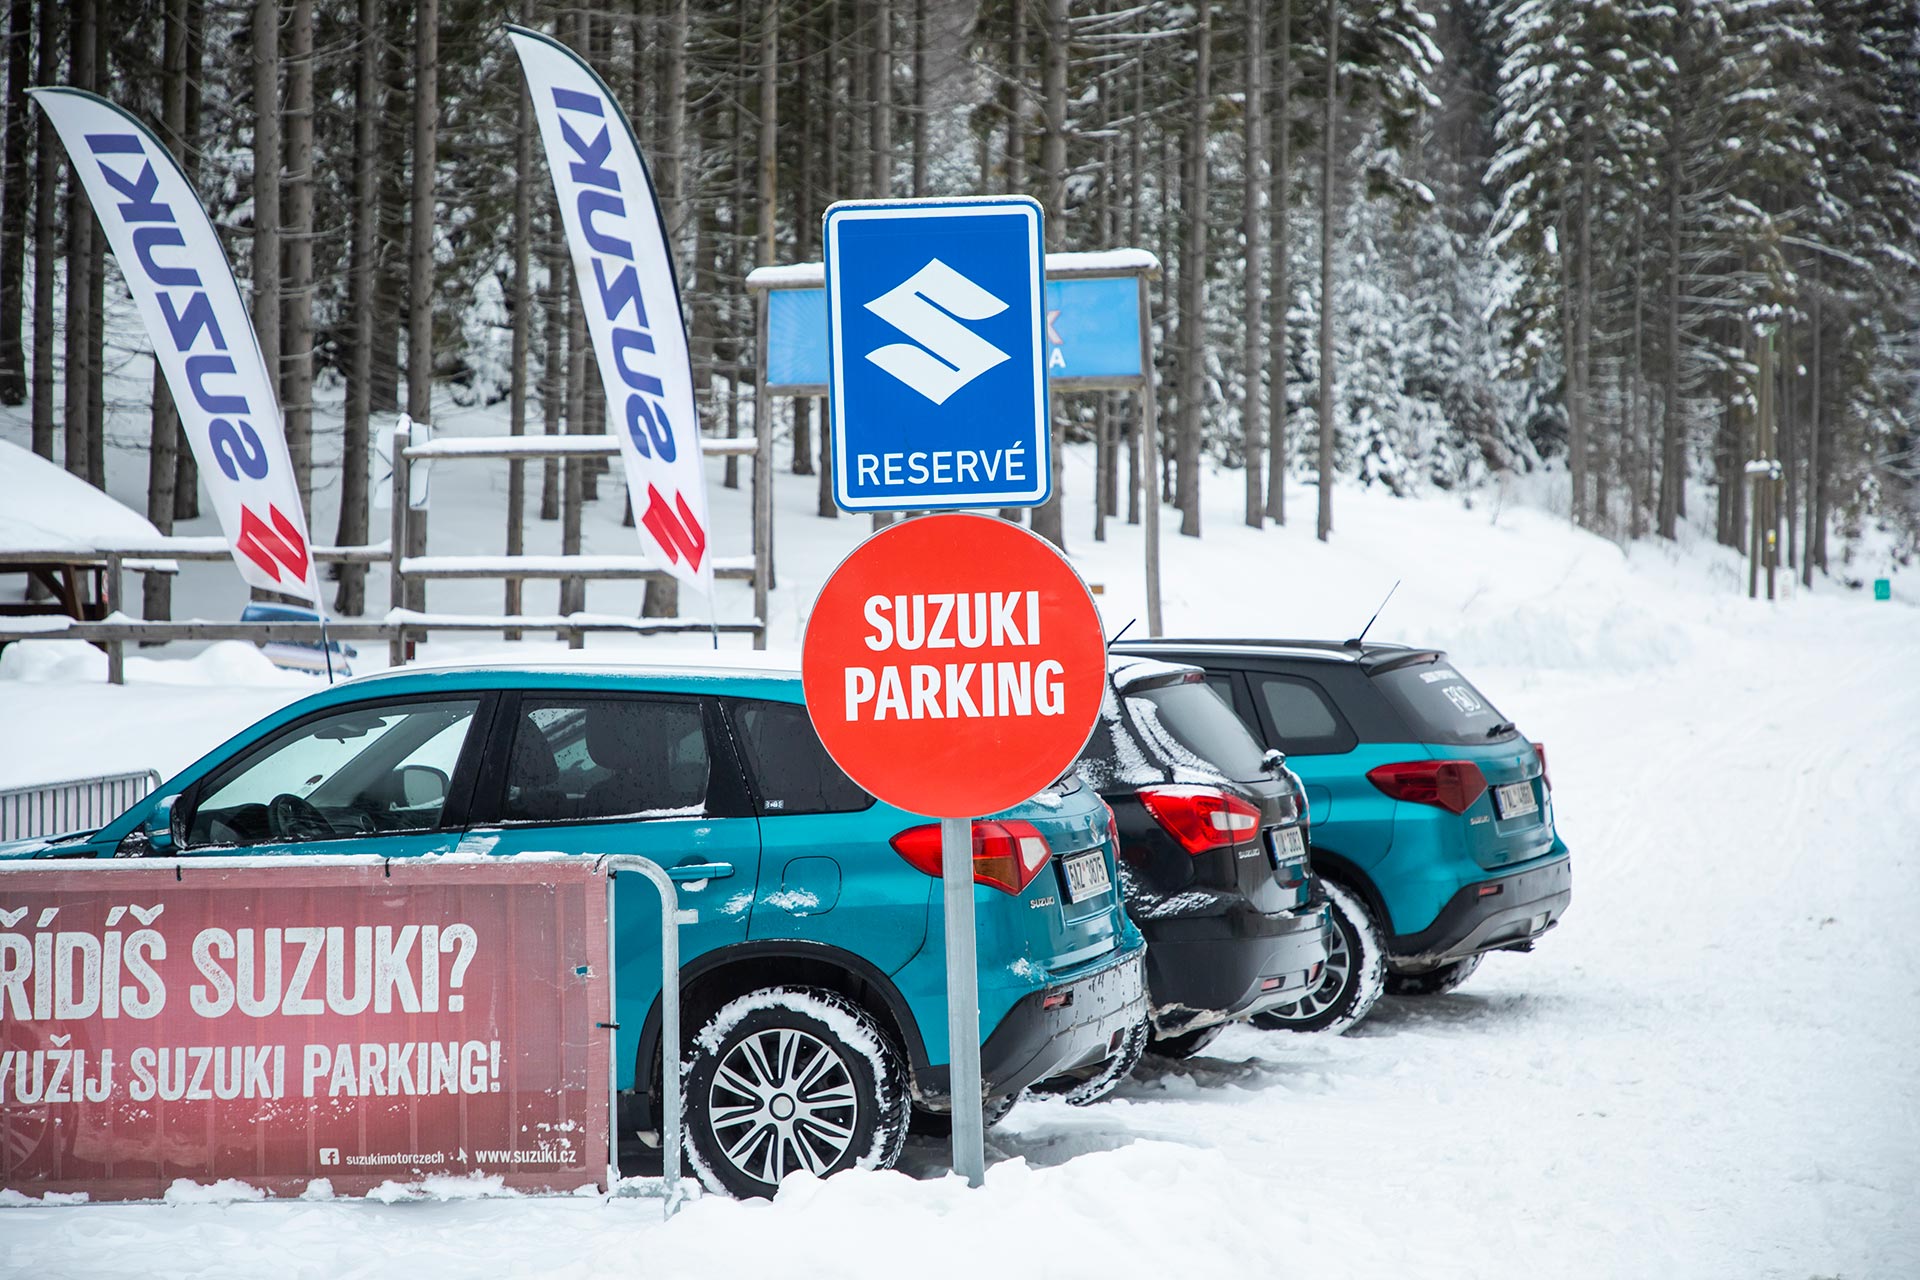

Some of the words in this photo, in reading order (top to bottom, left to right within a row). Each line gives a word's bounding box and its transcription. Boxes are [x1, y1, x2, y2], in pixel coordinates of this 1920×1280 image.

[858, 441, 1026, 486] RESERVÉ
[864, 590, 1040, 651] SUZUKI
[845, 660, 1065, 721] PARKING
[0, 903, 166, 1020] ŘÍDÍŠ
[190, 923, 478, 1018] SUZUKI?
[130, 1045, 285, 1101] SUZUKI
[303, 1040, 501, 1098] PARKING!
[346, 1150, 445, 1165] suzukimotorczech
[475, 1148, 577, 1164] www.suzuki.cz
